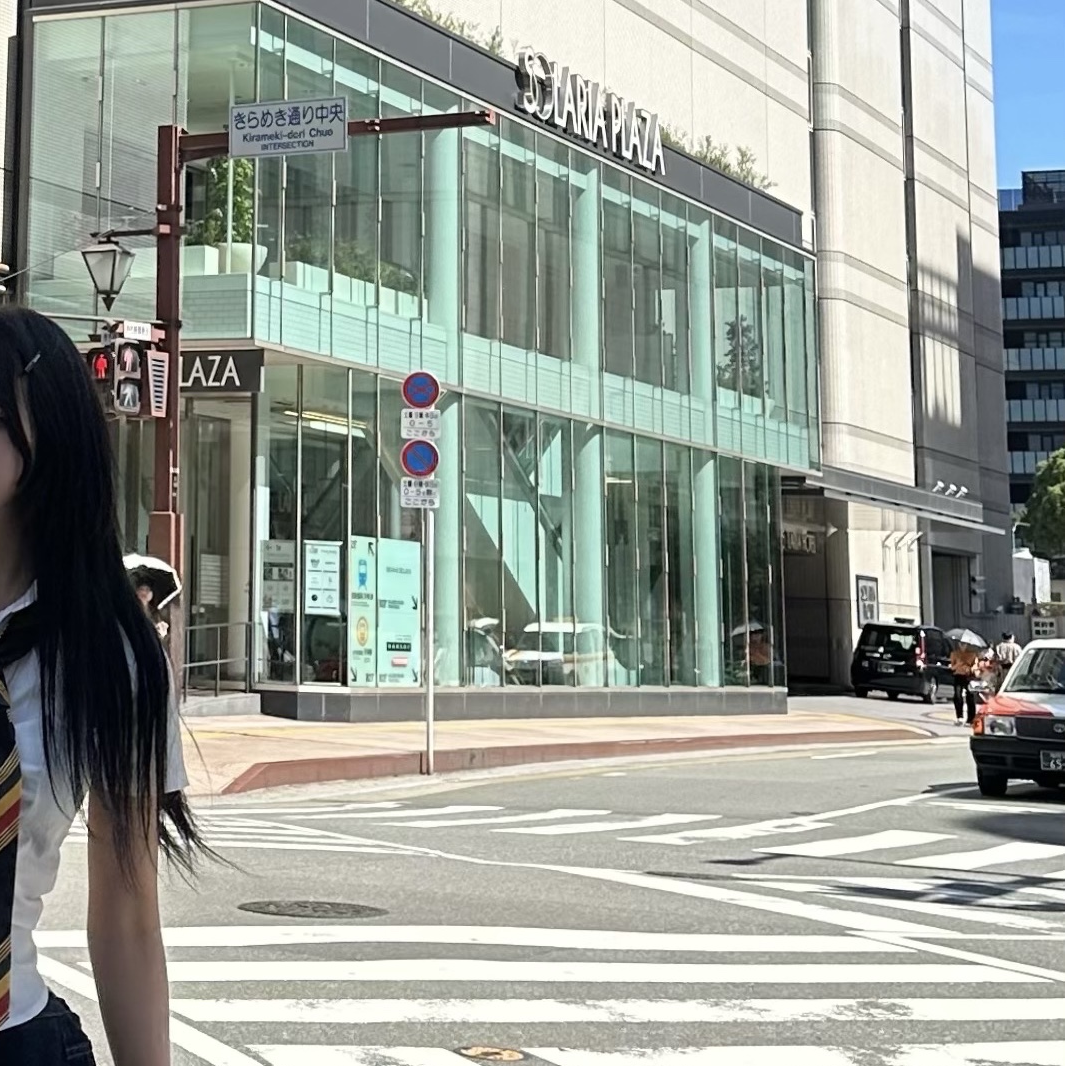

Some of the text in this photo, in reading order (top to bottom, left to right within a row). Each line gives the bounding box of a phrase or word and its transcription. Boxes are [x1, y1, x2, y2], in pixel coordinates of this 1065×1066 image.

[234, 103, 344, 130] きらめき通り中央
[517, 46, 666, 176] SOLARIA PLAZA
[242, 127, 334, 143] Kirameki-dori Chuo
[261, 139, 315, 151] INTERSECTION
[179, 355, 241, 387] LAZA
